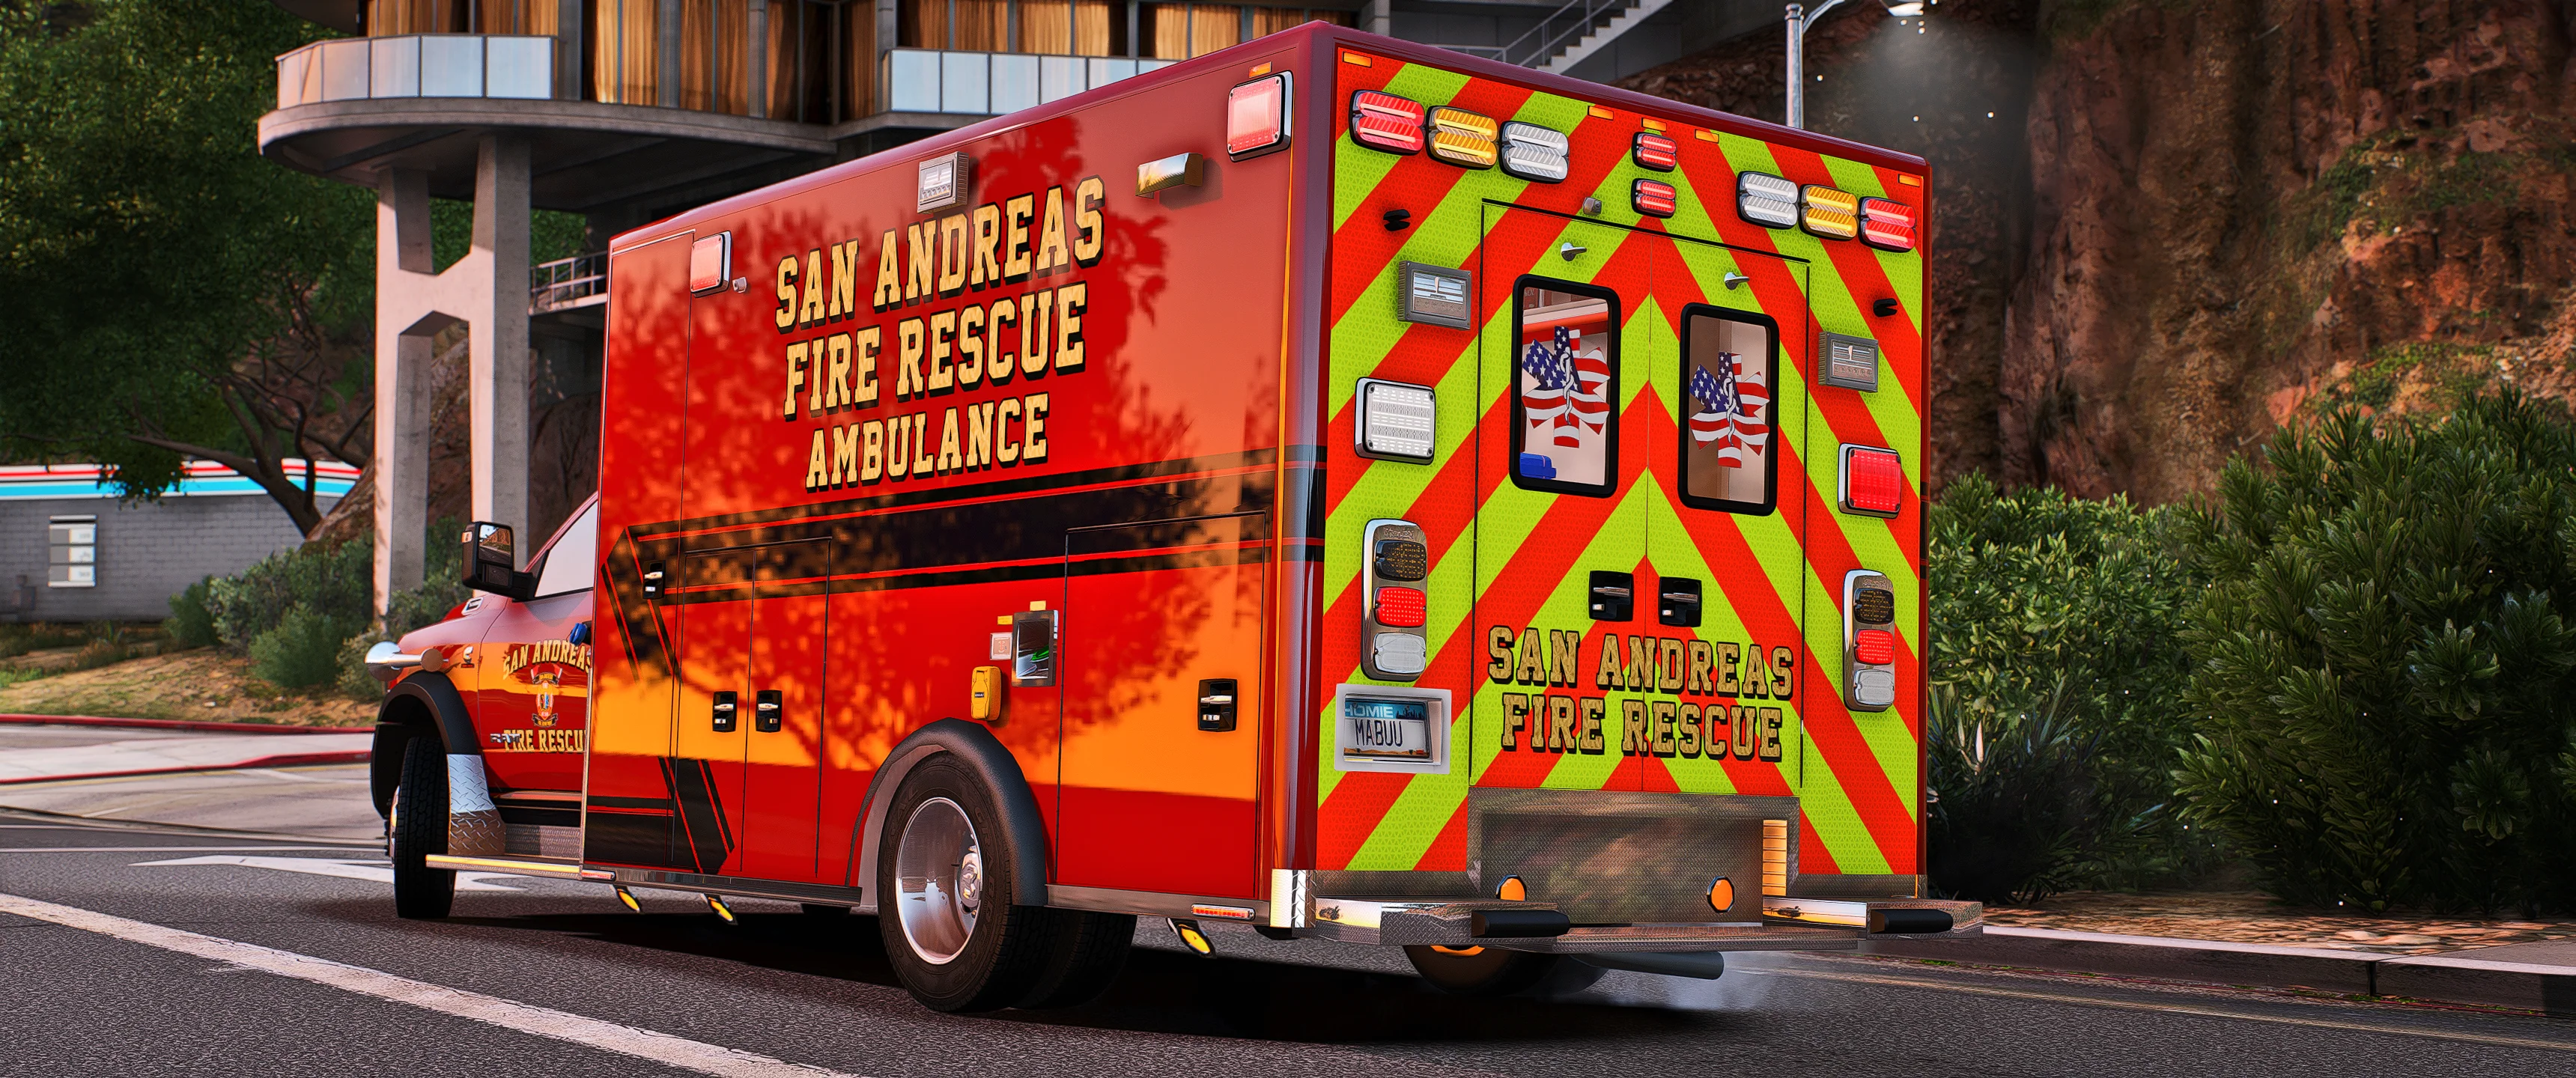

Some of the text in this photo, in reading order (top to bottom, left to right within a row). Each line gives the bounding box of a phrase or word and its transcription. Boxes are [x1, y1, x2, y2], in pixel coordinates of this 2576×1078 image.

[775, 174, 1105, 335] SAN ANDREAS
[783, 281, 1088, 421] FIRE RESCUE
[805, 391, 1049, 492] AMBULANCE
[502, 643, 529, 680] SAN
[1488, 625, 1794, 701] SAN ANDREAS
[538, 728, 586, 754] RESCU
[1354, 718, 1403, 747] MABUU
[1501, 692, 1783, 762] FIRE RESCUE
